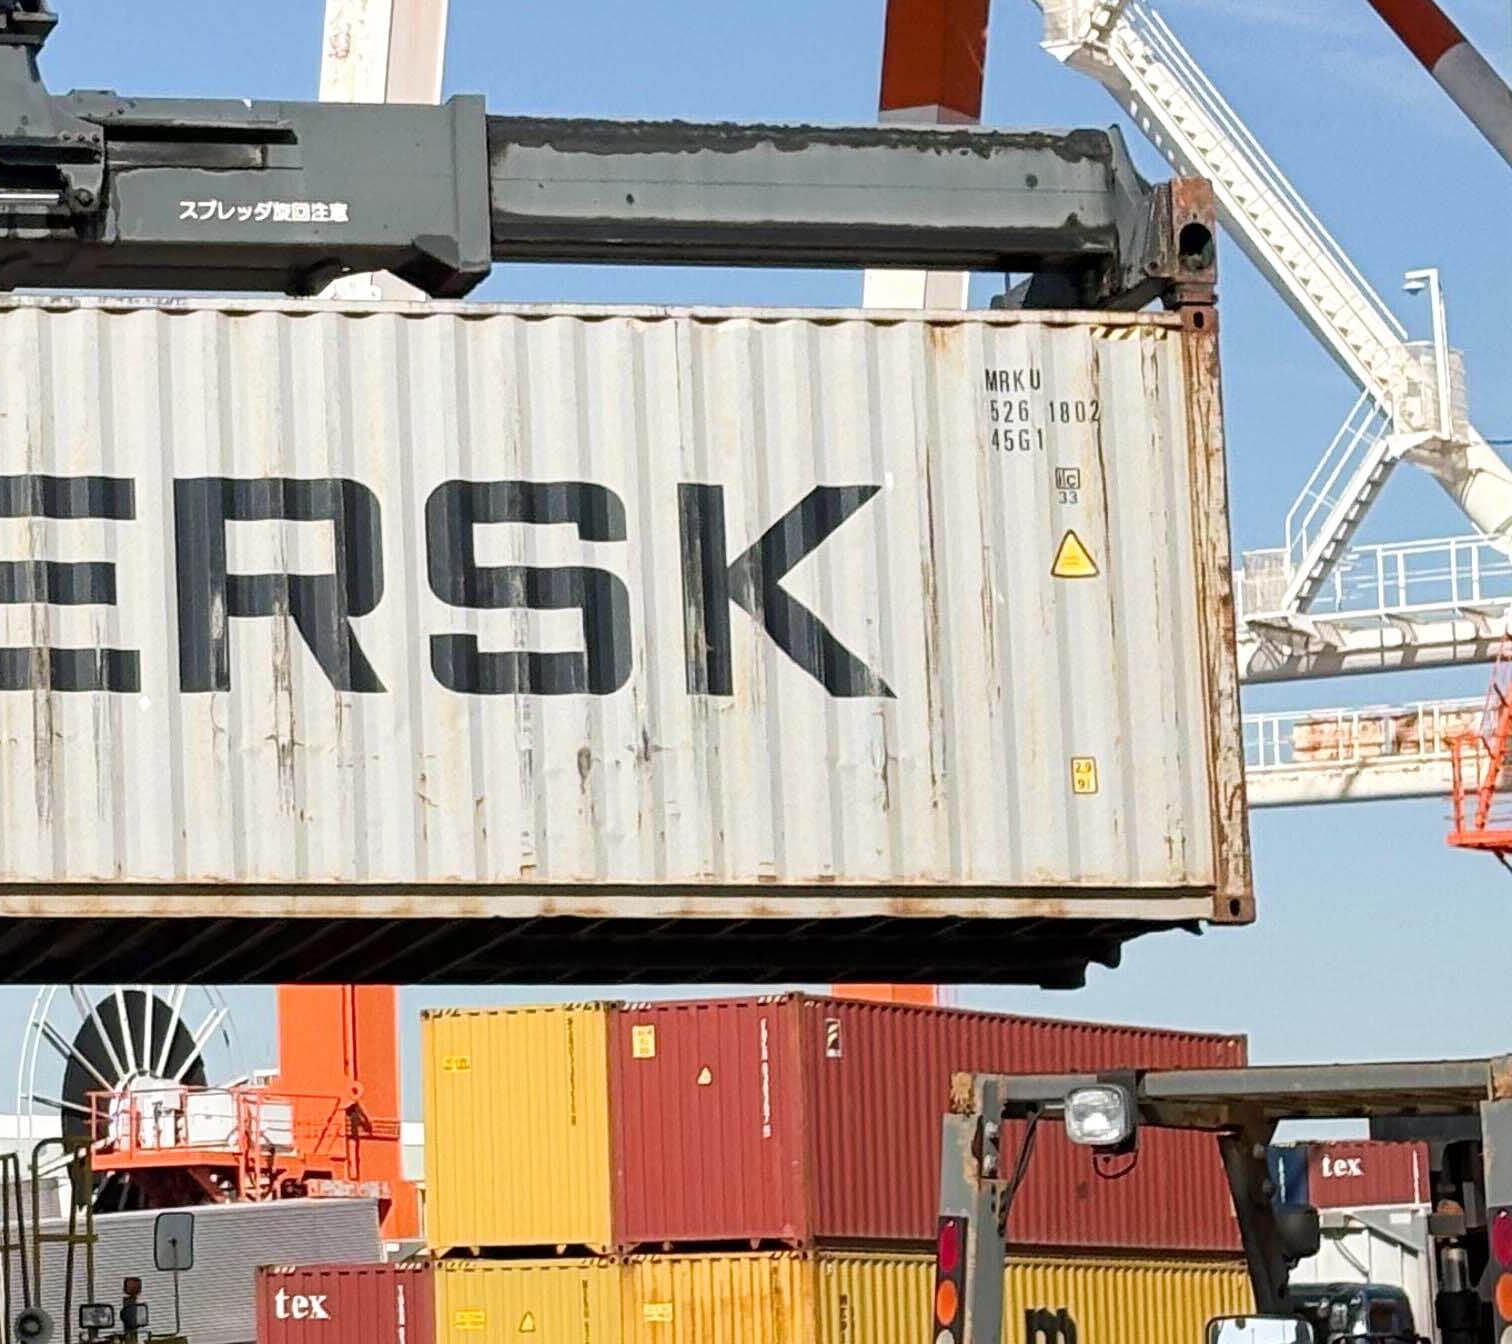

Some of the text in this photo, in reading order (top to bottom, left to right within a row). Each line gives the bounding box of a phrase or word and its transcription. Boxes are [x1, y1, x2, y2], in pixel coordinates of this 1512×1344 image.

[985, 368, 1041, 392] MRKU
[990, 399, 1100, 423] 526 1802
[991, 428, 1043, 452] 45G1
[1321, 1154, 1364, 1177] tex
[274, 1287, 331, 1320] tex
